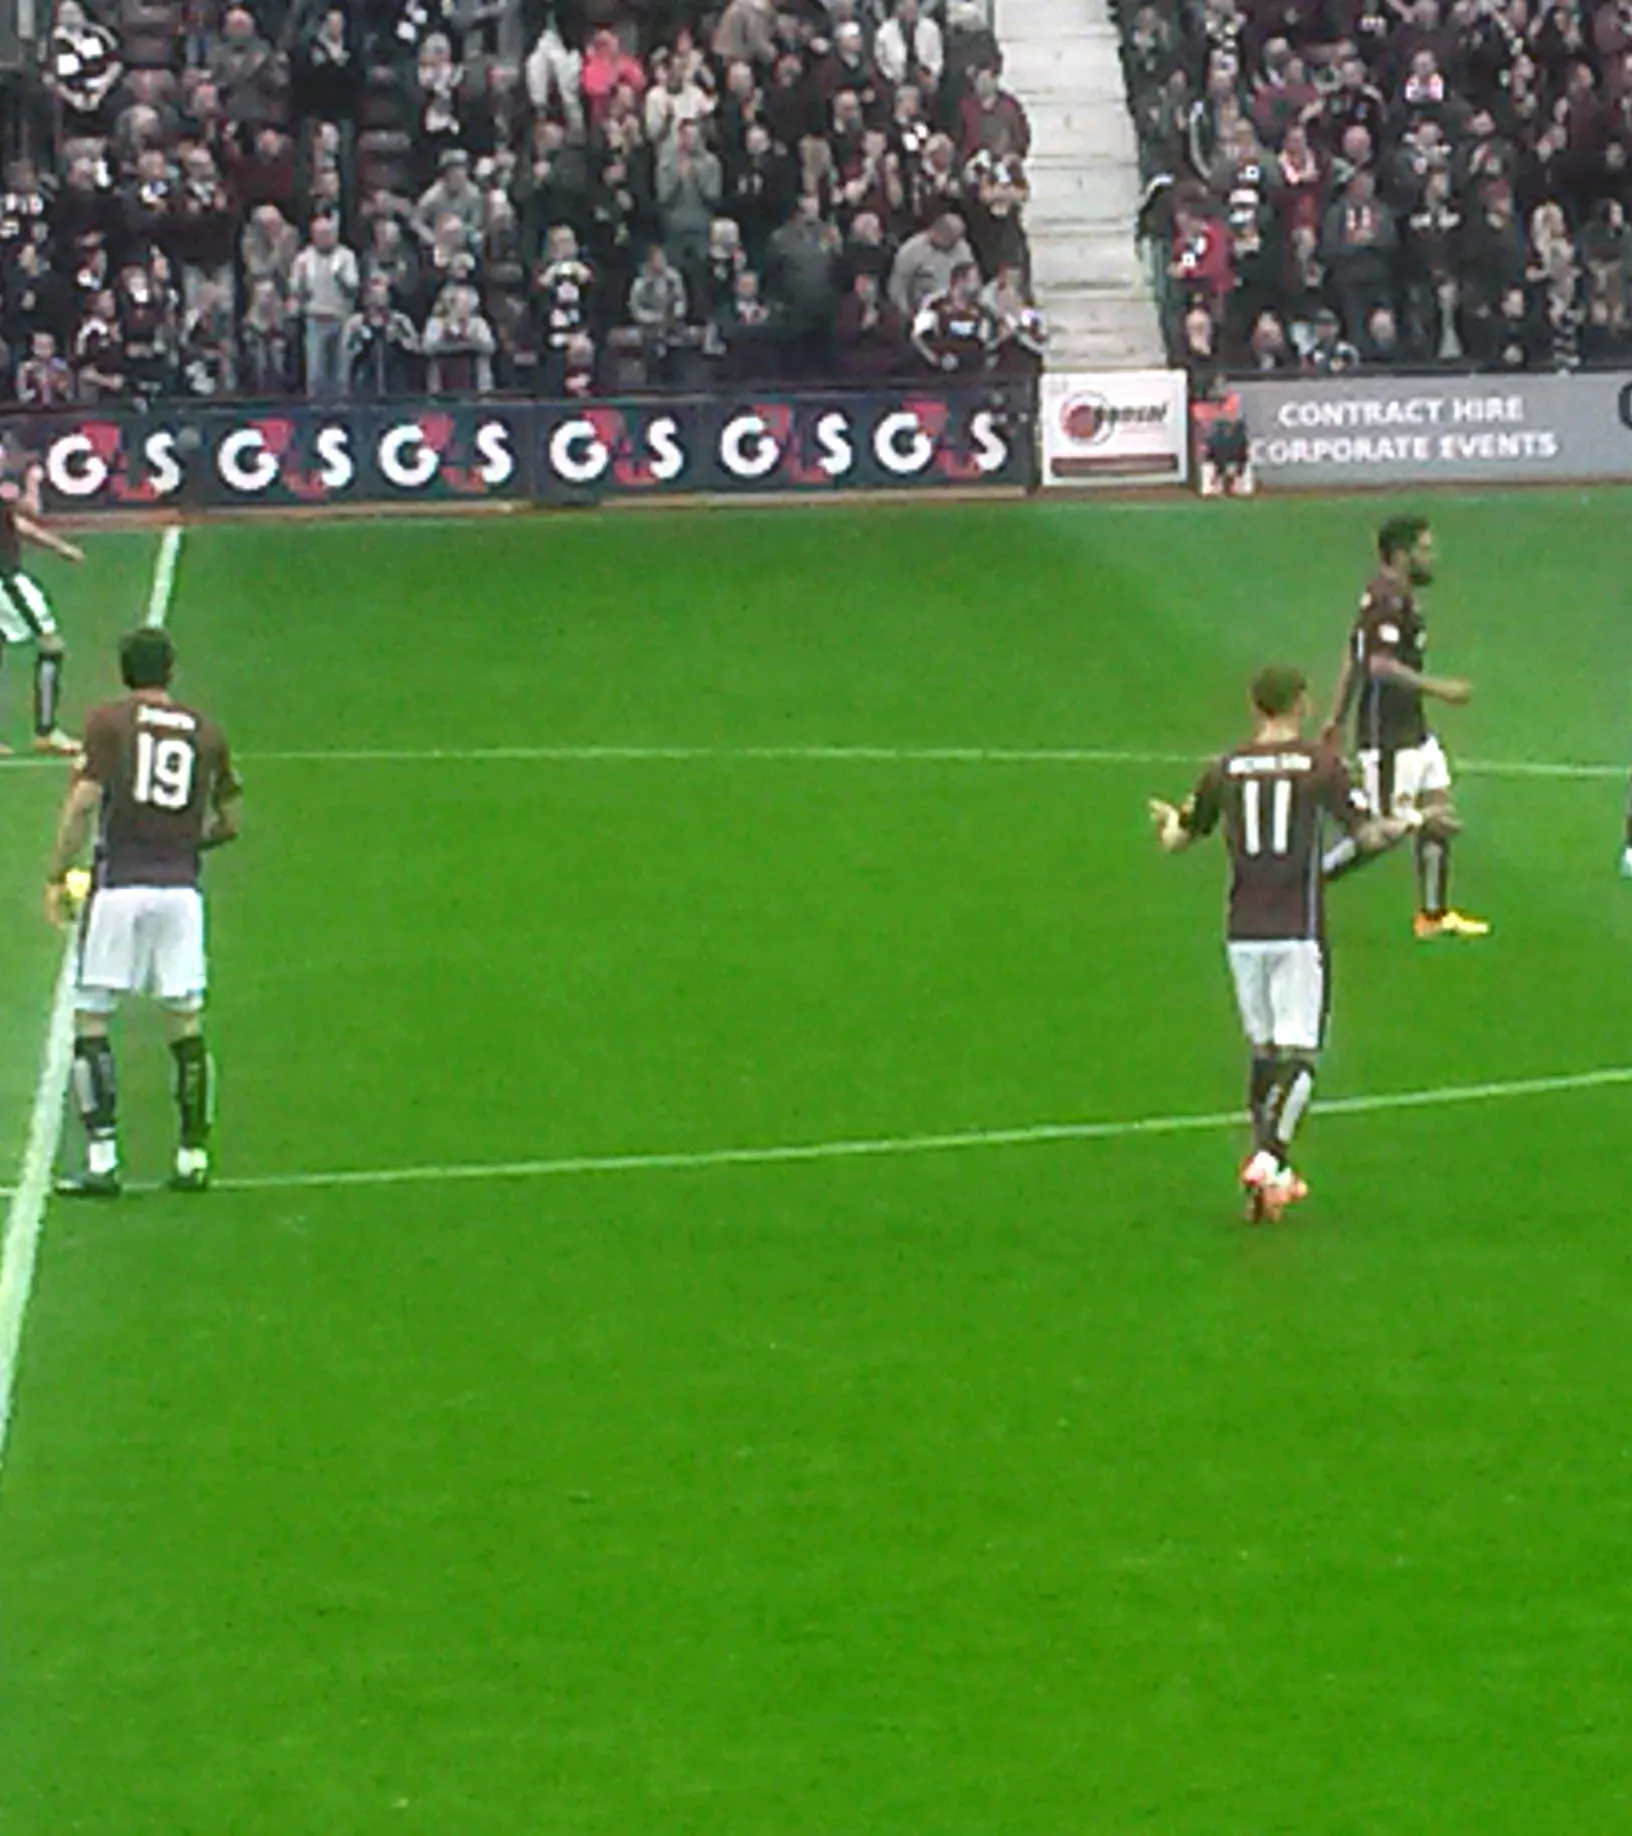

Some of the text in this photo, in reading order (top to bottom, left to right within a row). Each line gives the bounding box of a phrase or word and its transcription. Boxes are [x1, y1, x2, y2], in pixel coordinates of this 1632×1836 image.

[1277, 396, 1525, 428] CONTRACT HIRE
[1249, 431, 1559, 465] CORPORATE EVENTS
[132, 730, 195, 809] 19
[1242, 779, 1292, 855] 11
